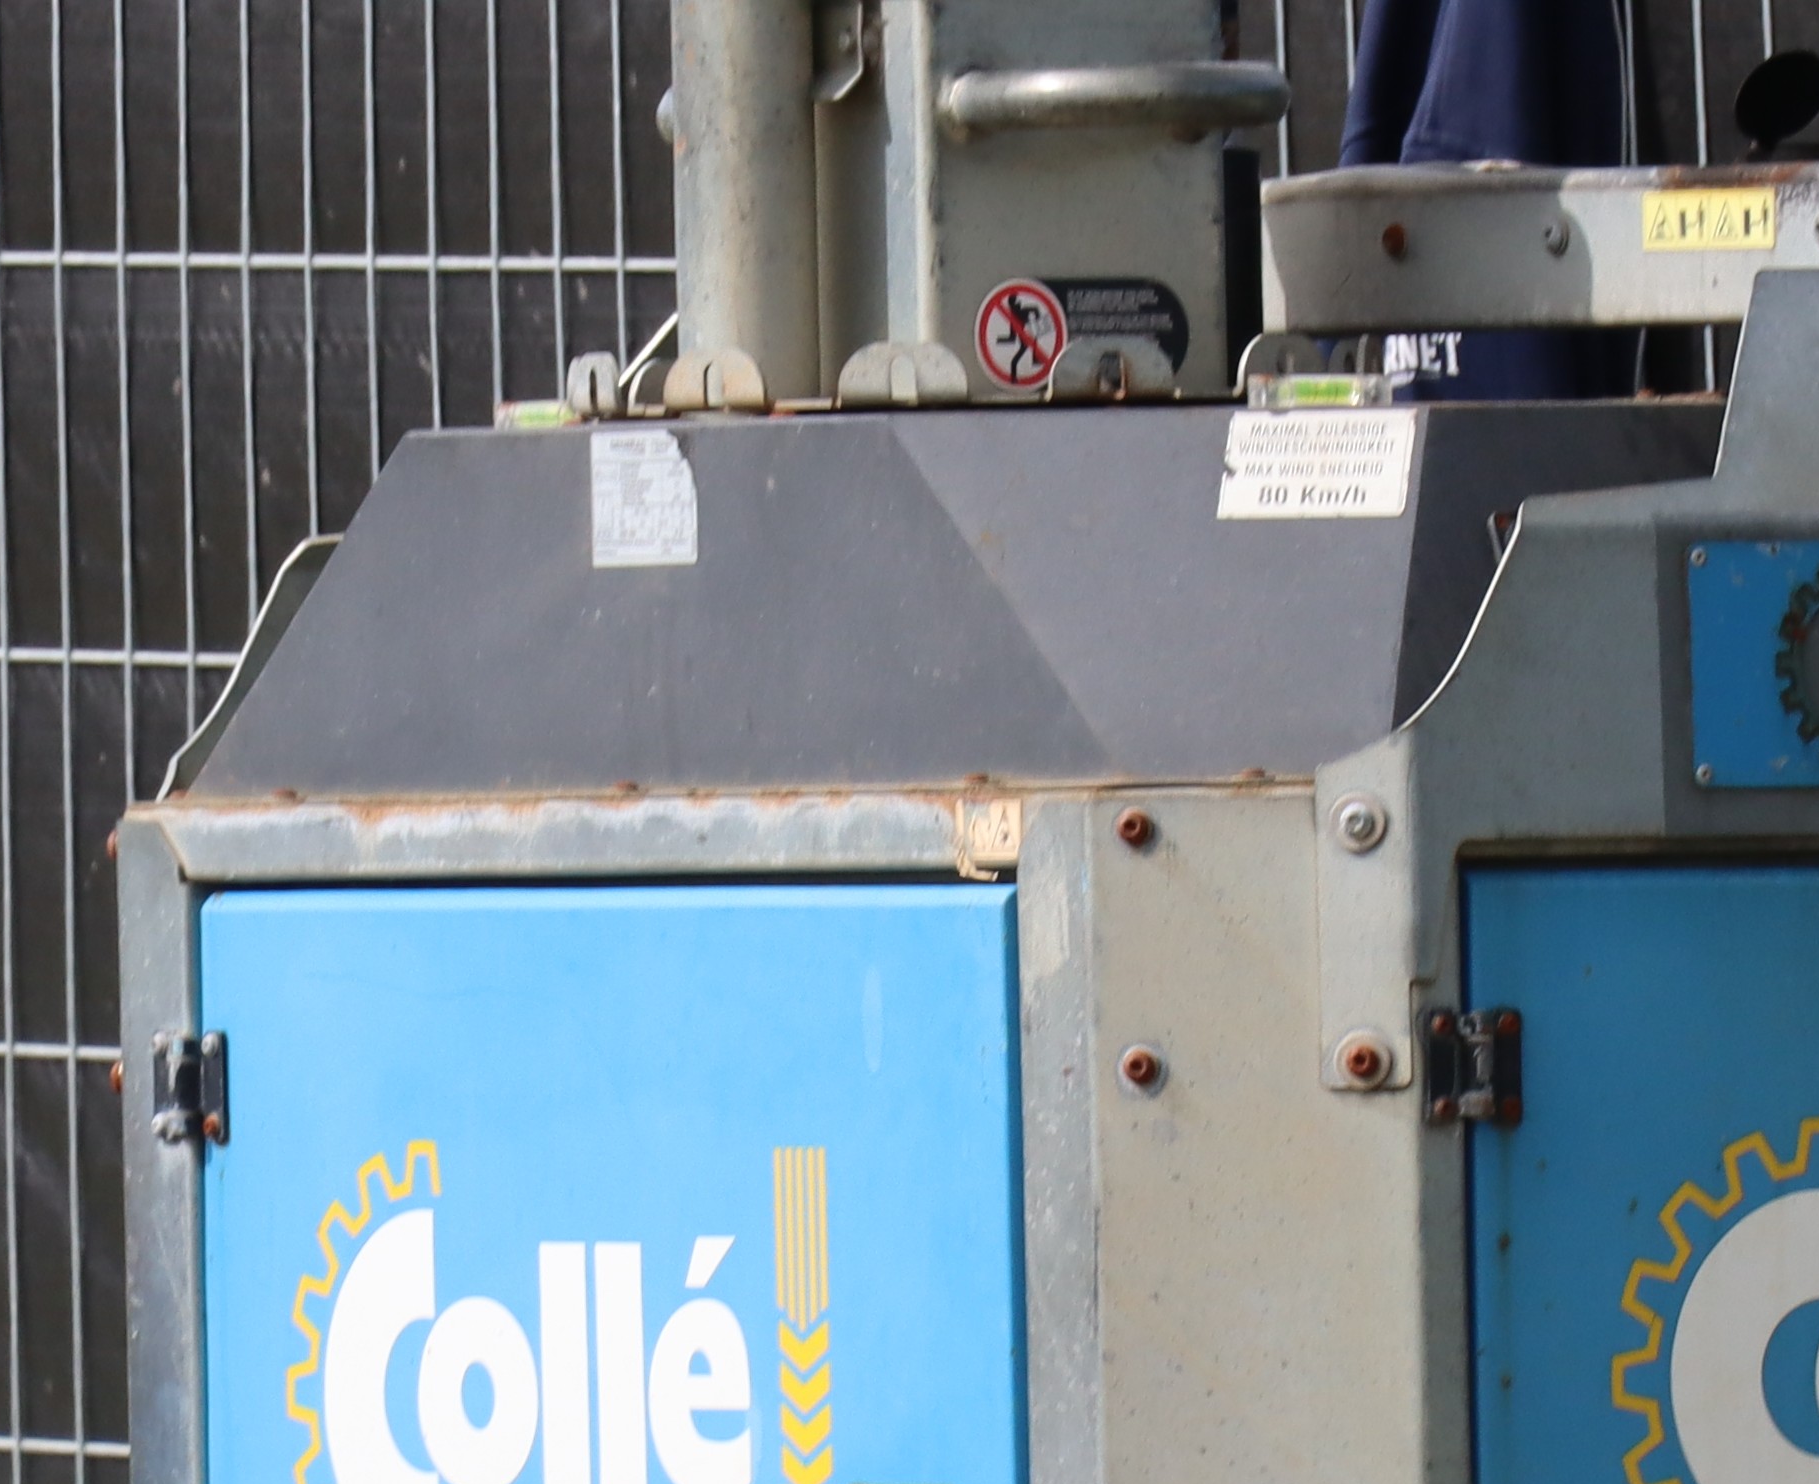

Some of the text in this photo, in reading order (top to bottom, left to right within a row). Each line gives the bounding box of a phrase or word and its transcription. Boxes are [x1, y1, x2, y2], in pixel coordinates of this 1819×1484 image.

[1250, 421, 1309, 437] MAXIMAL
[1244, 461, 1274, 477] MAX
[1278, 461, 1314, 477] WIND
[1258, 484, 1367, 506] 80 Km/h
